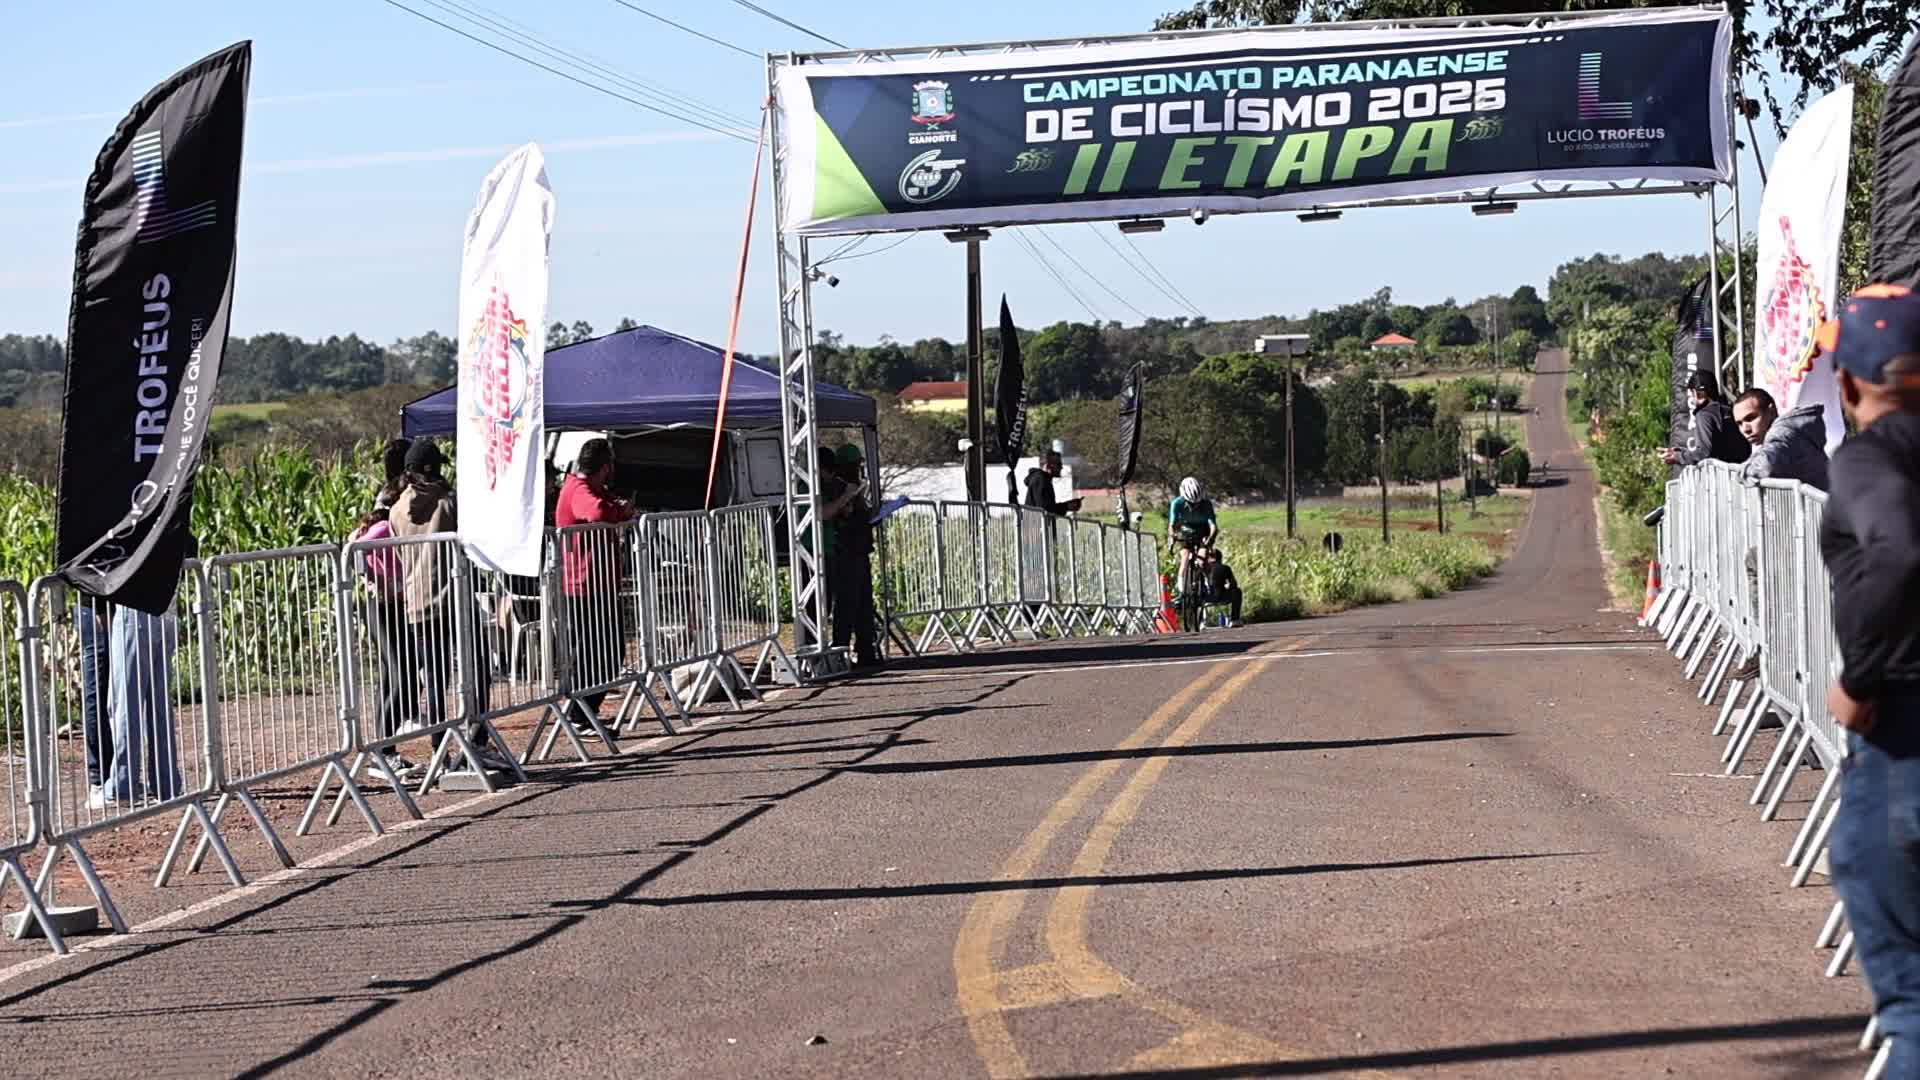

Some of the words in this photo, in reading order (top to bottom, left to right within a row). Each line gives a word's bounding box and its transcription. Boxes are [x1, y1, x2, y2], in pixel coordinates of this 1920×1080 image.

[1023, 67, 1262, 103] CAMPEONATO
[1272, 50, 1509, 89] PARANAENSE
[1025, 106, 1094, 143] DE
[1110, 89, 1351, 139] CICLÍSMO
[1368, 77, 1506, 122] 2025
[1547, 128, 1594, 143] LUCIO
[1598, 125, 1665, 140] TROFÉUS
[908, 134, 957, 144] CIANORTE
[1063, 140, 1137, 195] II
[1159, 118, 1455, 190] ETAPA
[133, 273, 171, 463] TROFÉUS
[182, 385, 198, 433] VOCÊ
